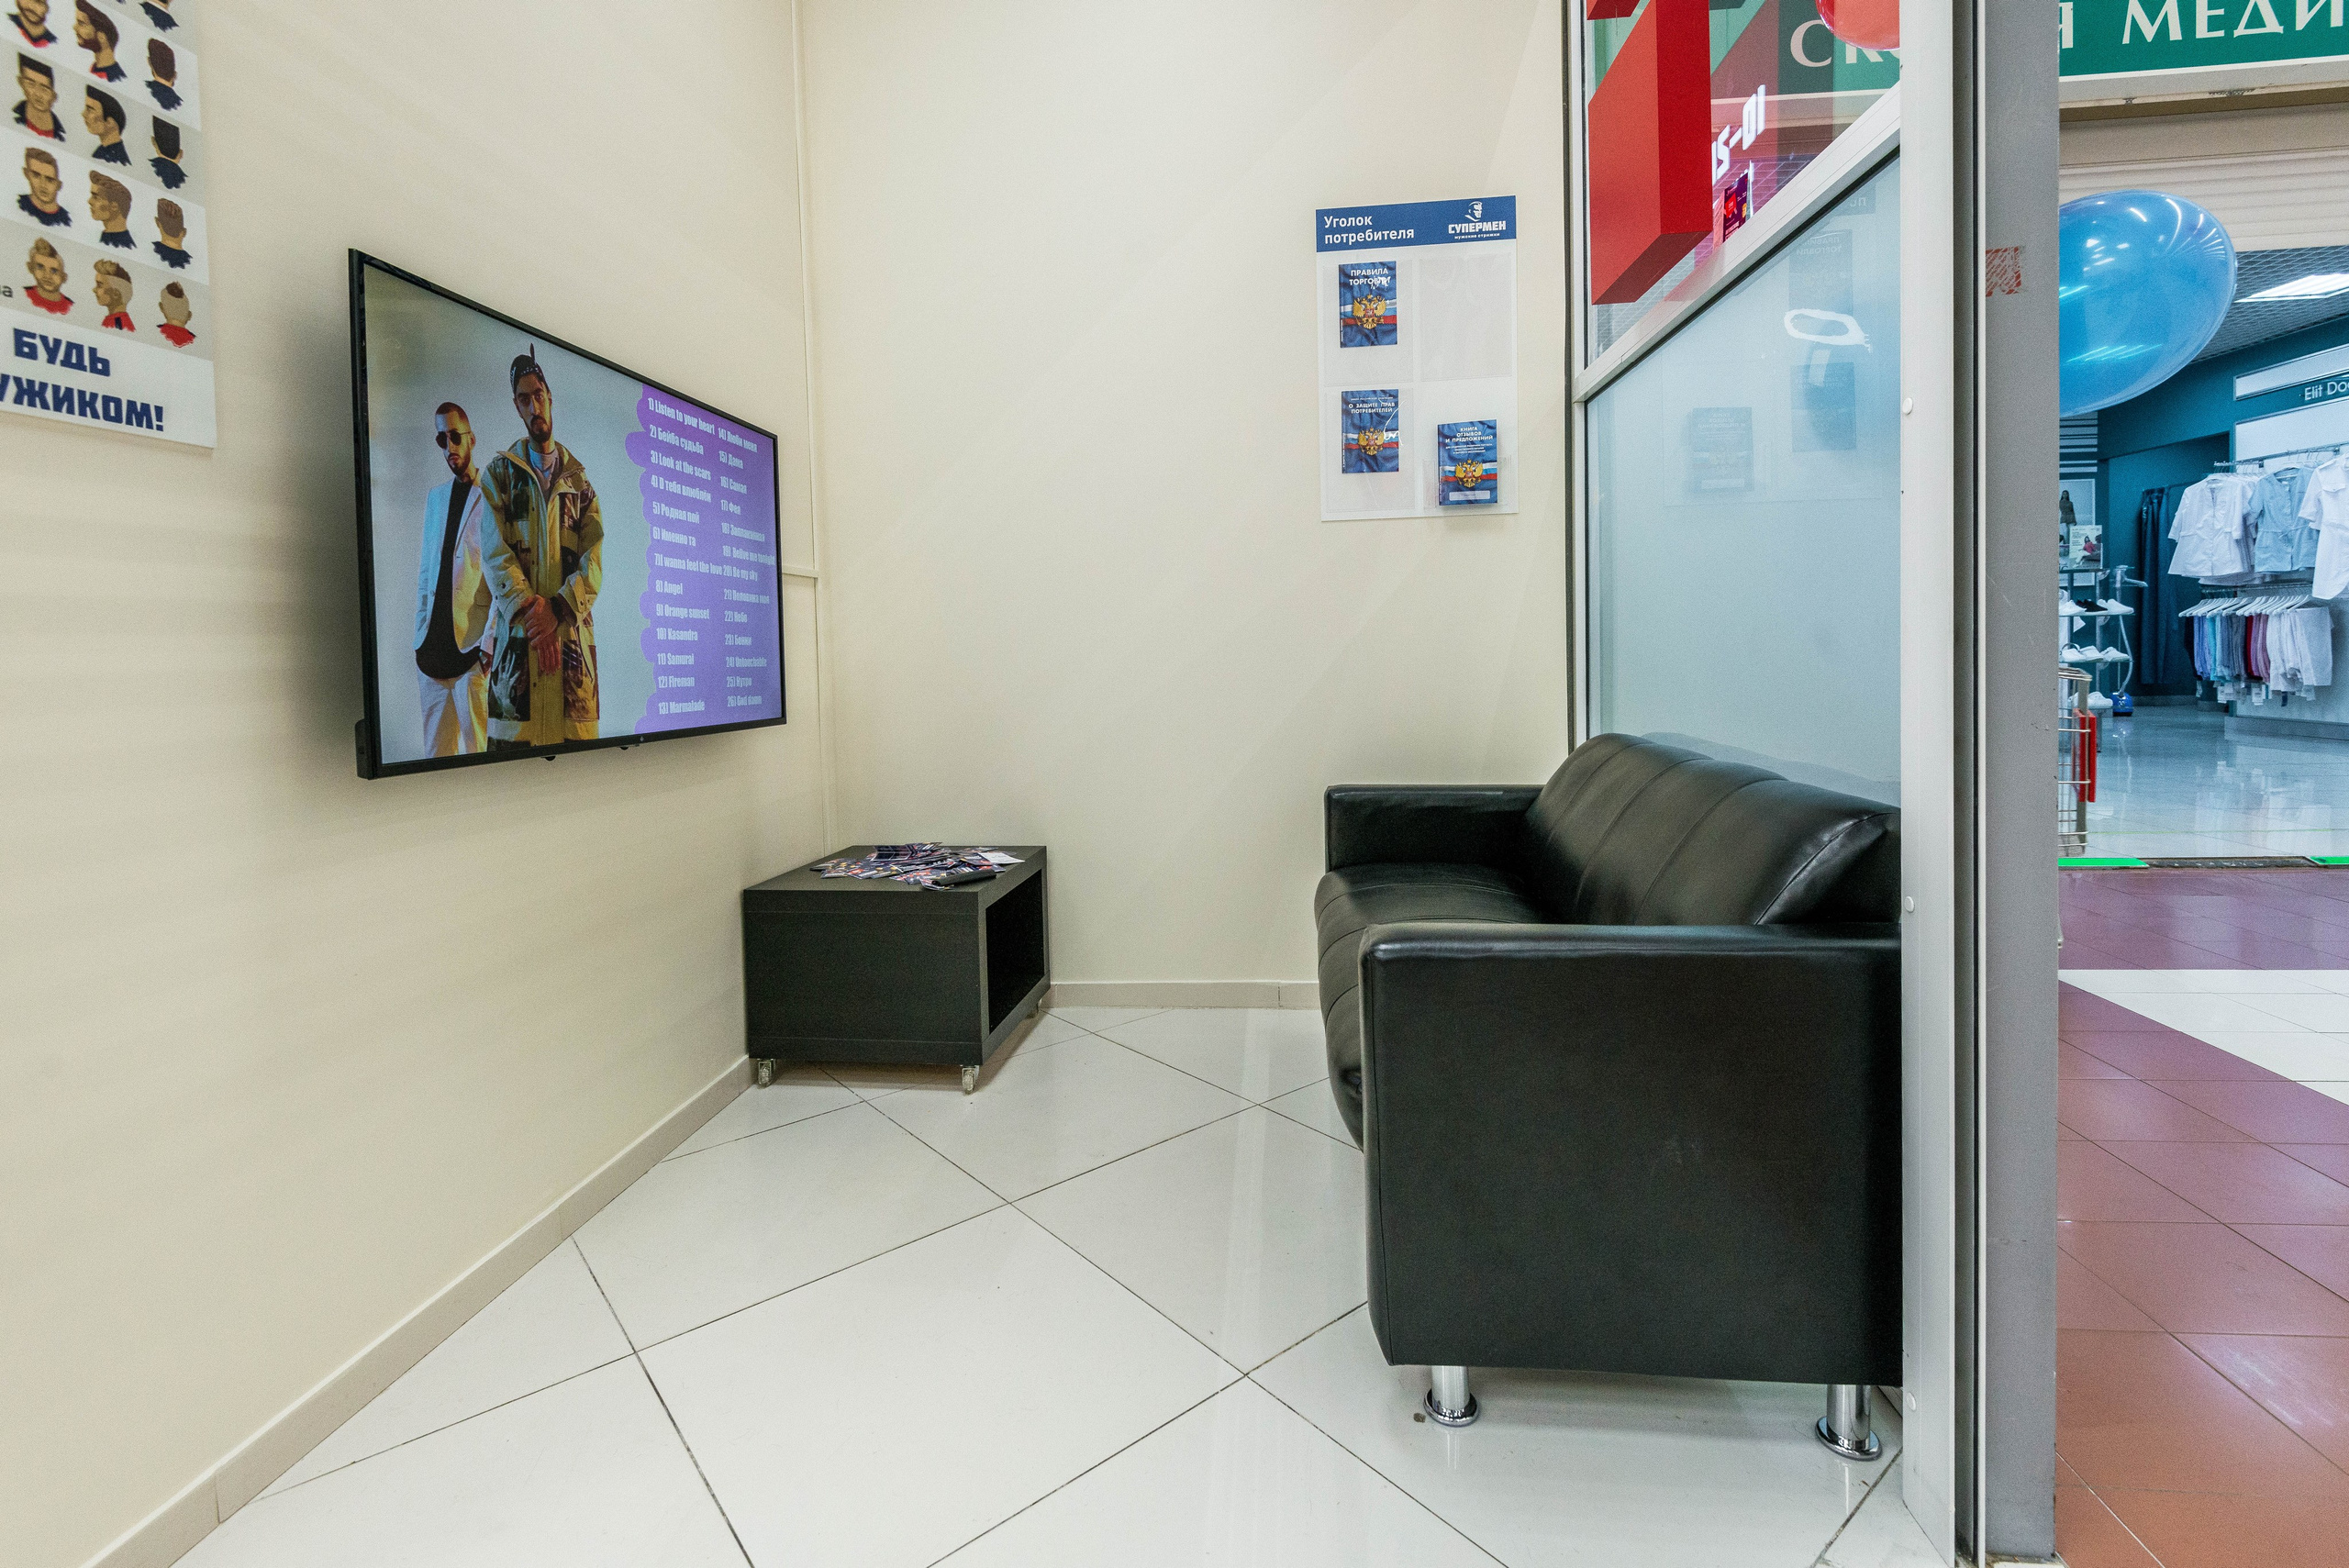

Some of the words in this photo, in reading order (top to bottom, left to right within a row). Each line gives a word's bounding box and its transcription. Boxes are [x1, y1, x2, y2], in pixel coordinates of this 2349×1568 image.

[1324, 216, 1373, 228] Уголок
[1448, 220, 1506, 234] СУПЕРМЕН
[1325, 228, 1414, 246] потребителя
[1351, 268, 1388, 276] ПРАВИЛА
[13, 328, 111, 377] БУДЬ
[2304, 384, 2323, 401] Elit
[2327, 382, 2349, 395] Do
[655, 400, 675, 419] Listen
[676, 409, 684, 422] to
[684, 413, 698, 428] your
[698, 417, 715, 435] heart
[659, 452, 674, 469] Look
[675, 461, 683, 472] at
[683, 462, 694, 475] the
